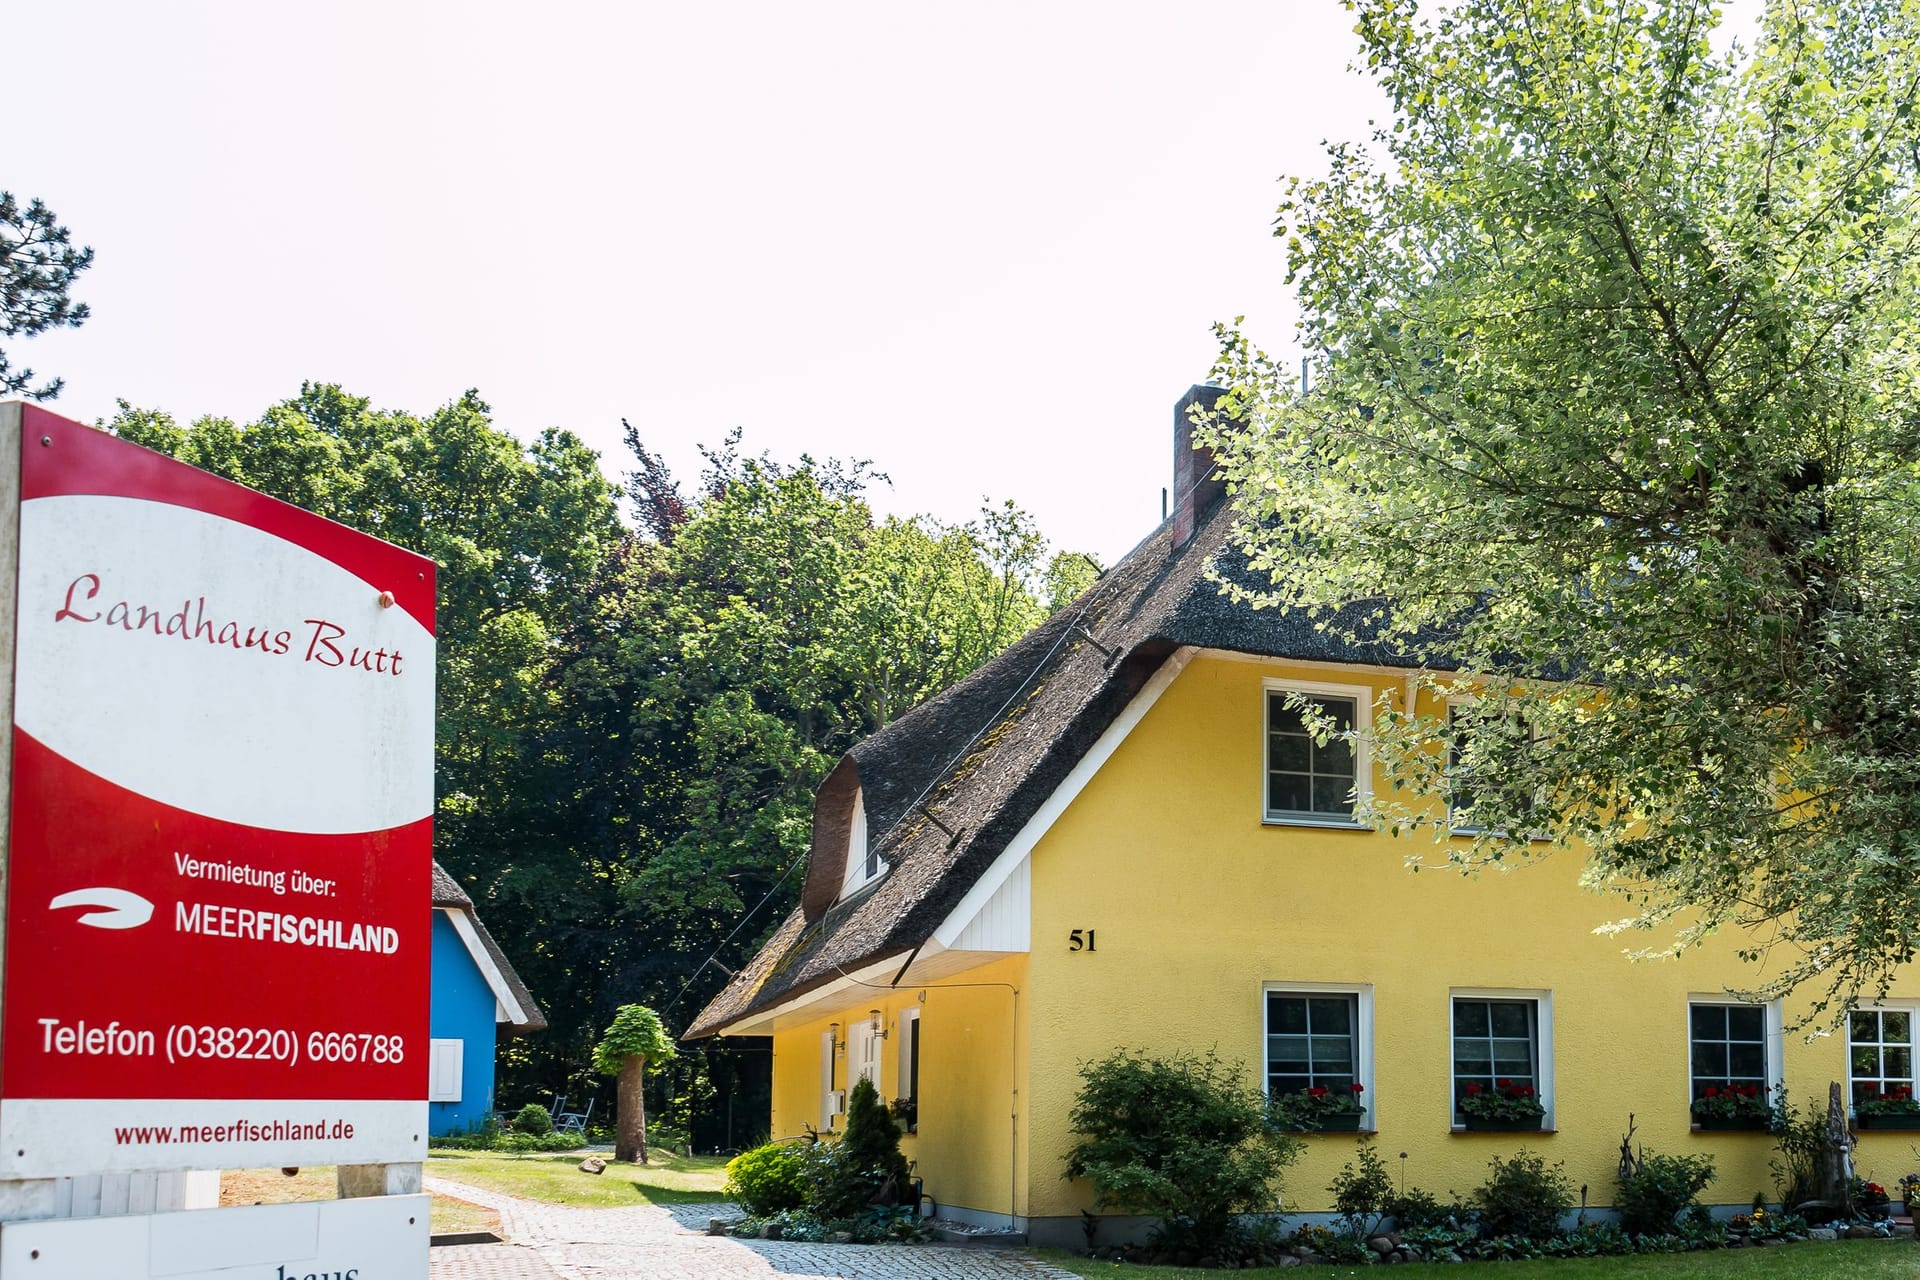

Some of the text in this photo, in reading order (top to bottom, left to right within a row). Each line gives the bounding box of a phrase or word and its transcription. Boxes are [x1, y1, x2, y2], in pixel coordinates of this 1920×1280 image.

[56, 573, 403, 676] Landhaus Butt
[174, 852, 337, 897] Vermietung über:
[175, 901, 399, 954] MEERFISCHLAND
[1069, 929, 1097, 952] 51
[38, 1018, 404, 1067] Telefon (038220) 666788
[115, 1119, 355, 1145] www.meerfischland.de
